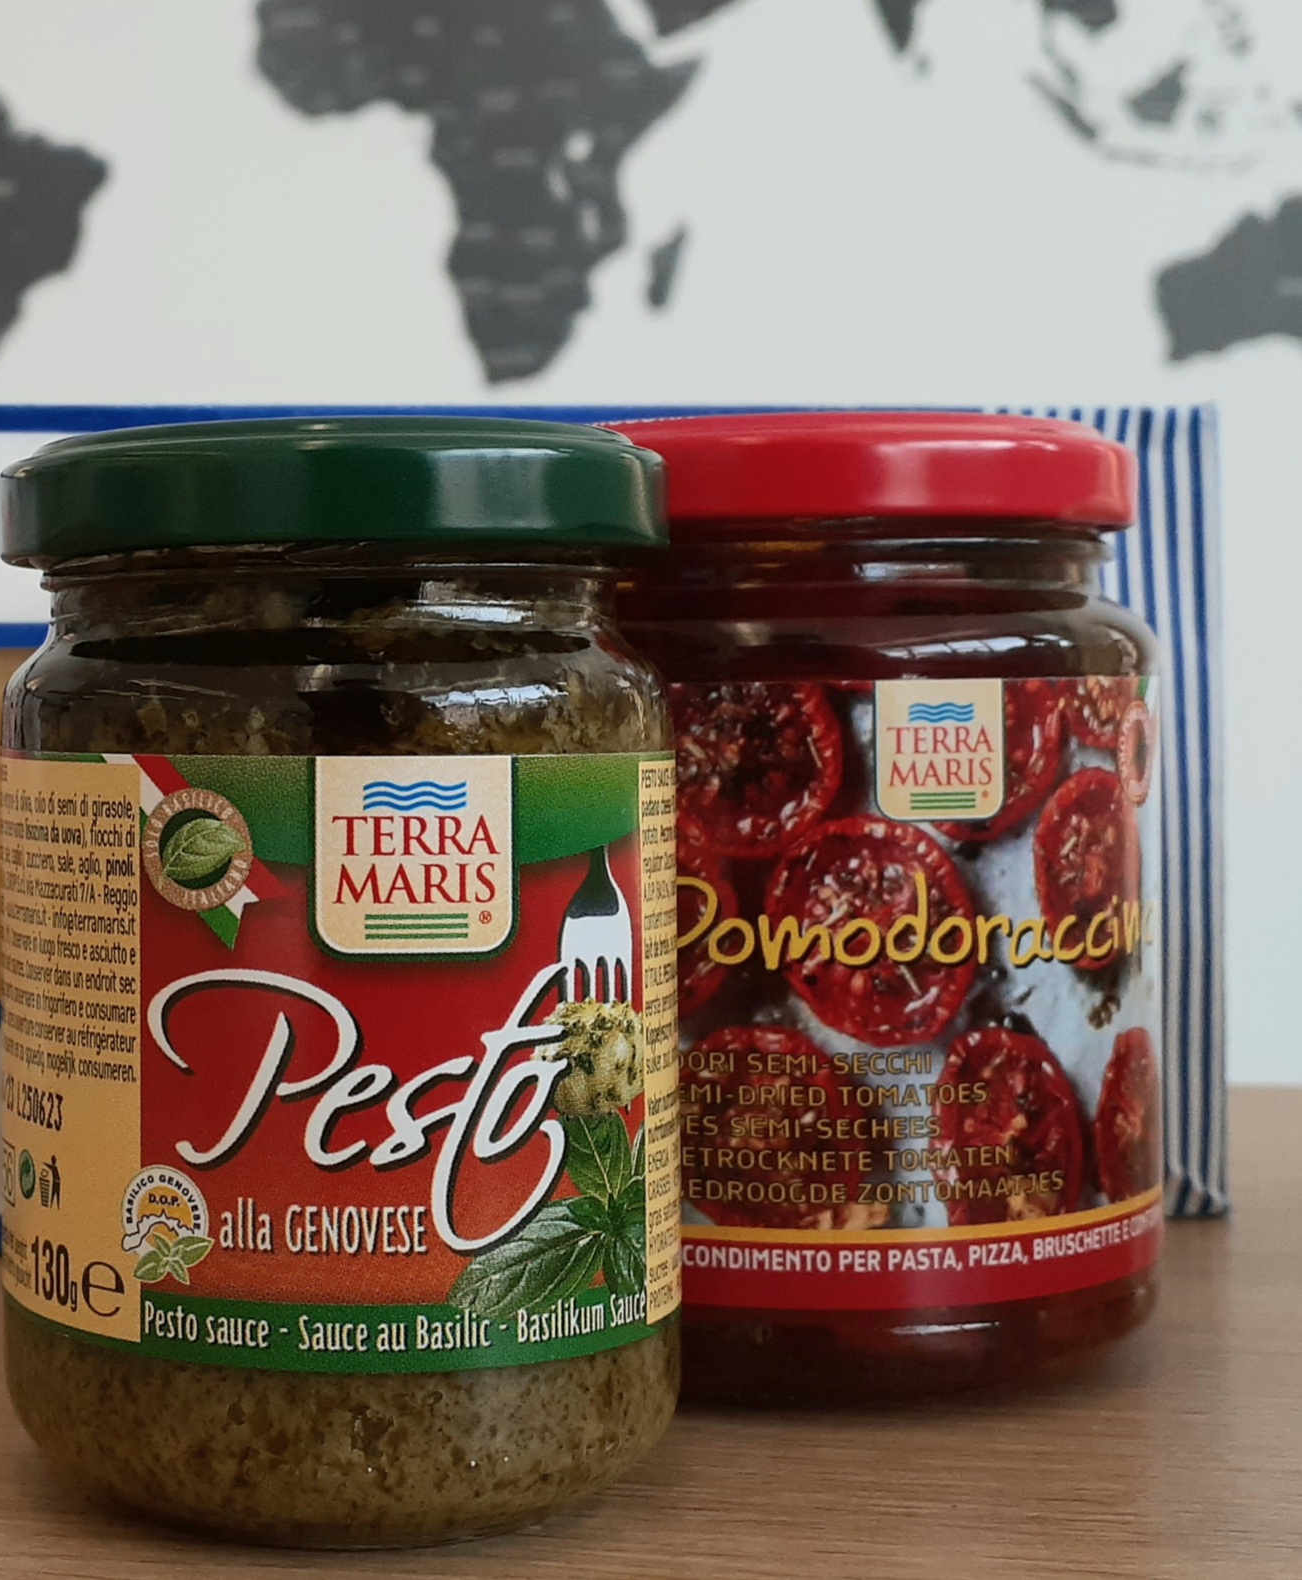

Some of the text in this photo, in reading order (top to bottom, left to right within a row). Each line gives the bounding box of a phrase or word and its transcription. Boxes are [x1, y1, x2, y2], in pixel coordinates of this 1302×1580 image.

[886, 725, 995, 755] TERRA
[888, 757, 993, 788] MARIS
[57, 793, 77, 817] semi
[80, 793, 89, 818] di
[92, 795, 136, 824] girasole,
[50, 820, 60, 844] da
[90, 820, 123, 848] fiocchi
[125, 824, 136, 848] di
[331, 814, 501, 856] TERRA
[57, 849, 76, 875] sale,
[78, 852, 102, 880] aglio,
[106, 853, 136, 882] pinoli.
[103, 883, 138, 912] Reggio
[332, 862, 496, 904] MARIS
[52, 905, 136, 936] info@terramaris.it
[677, 872, 1153, 972] Pomodoraccin
[56, 934, 81, 960] fresco
[89, 940, 127, 965] asciutto
[129, 947, 136, 965] e
[53, 963, 71, 988] dans
[73, 972, 84, 990] un
[85, 967, 117, 993] endroit
[119, 975, 136, 995] sec
[85, 1000, 136, 1025] consumare
[66, 1028, 77, 1046] au
[77, 1022, 137, 1056] réfrigérateur
[78, 1058, 137, 1083] consumeren.
[747, 1051, 932, 1075] SEMI-SECCHI
[17, 1081, 64, 1131] L250623
[147, 960, 568, 1252] Pesto
[679, 1082, 828, 1106] EMI-DRIED
[838, 1081, 988, 1107] TOMATOES
[682, 1114, 719, 1136] ES
[730, 1115, 941, 1139] SEMI-SECHEES
[681, 1146, 873, 1171] ETROCKNETE
[885, 1145, 1011, 1171] TOMATEN
[125, 1174, 201, 1231] BASILICO GENOVESE
[148, 1193, 181, 1208] D.O.P.
[681, 1170, 1065, 1204] EDROOGDE ZONTOMAATJES
[219, 1197, 428, 1254] alla GENOVESE
[681, 1244, 832, 1273] CONDIMENTO
[839, 1250, 881, 1273] PER
[887, 1246, 963, 1272] PASTA,
[968, 1239, 1029, 1268] PIZZA,
[1032, 1221, 1122, 1261] BRUSCHETTE
[31, 1235, 78, 1312] 130g
[144, 1300, 199, 1342] Pesto
[206, 1316, 270, 1348] sauce
[298, 1314, 369, 1351] Sauce
[376, 1322, 407, 1351] au
[416, 1308, 493, 1350] Basilic
[517, 1296, 606, 1344] Basilikum
[610, 1288, 646, 1328] Sauce
